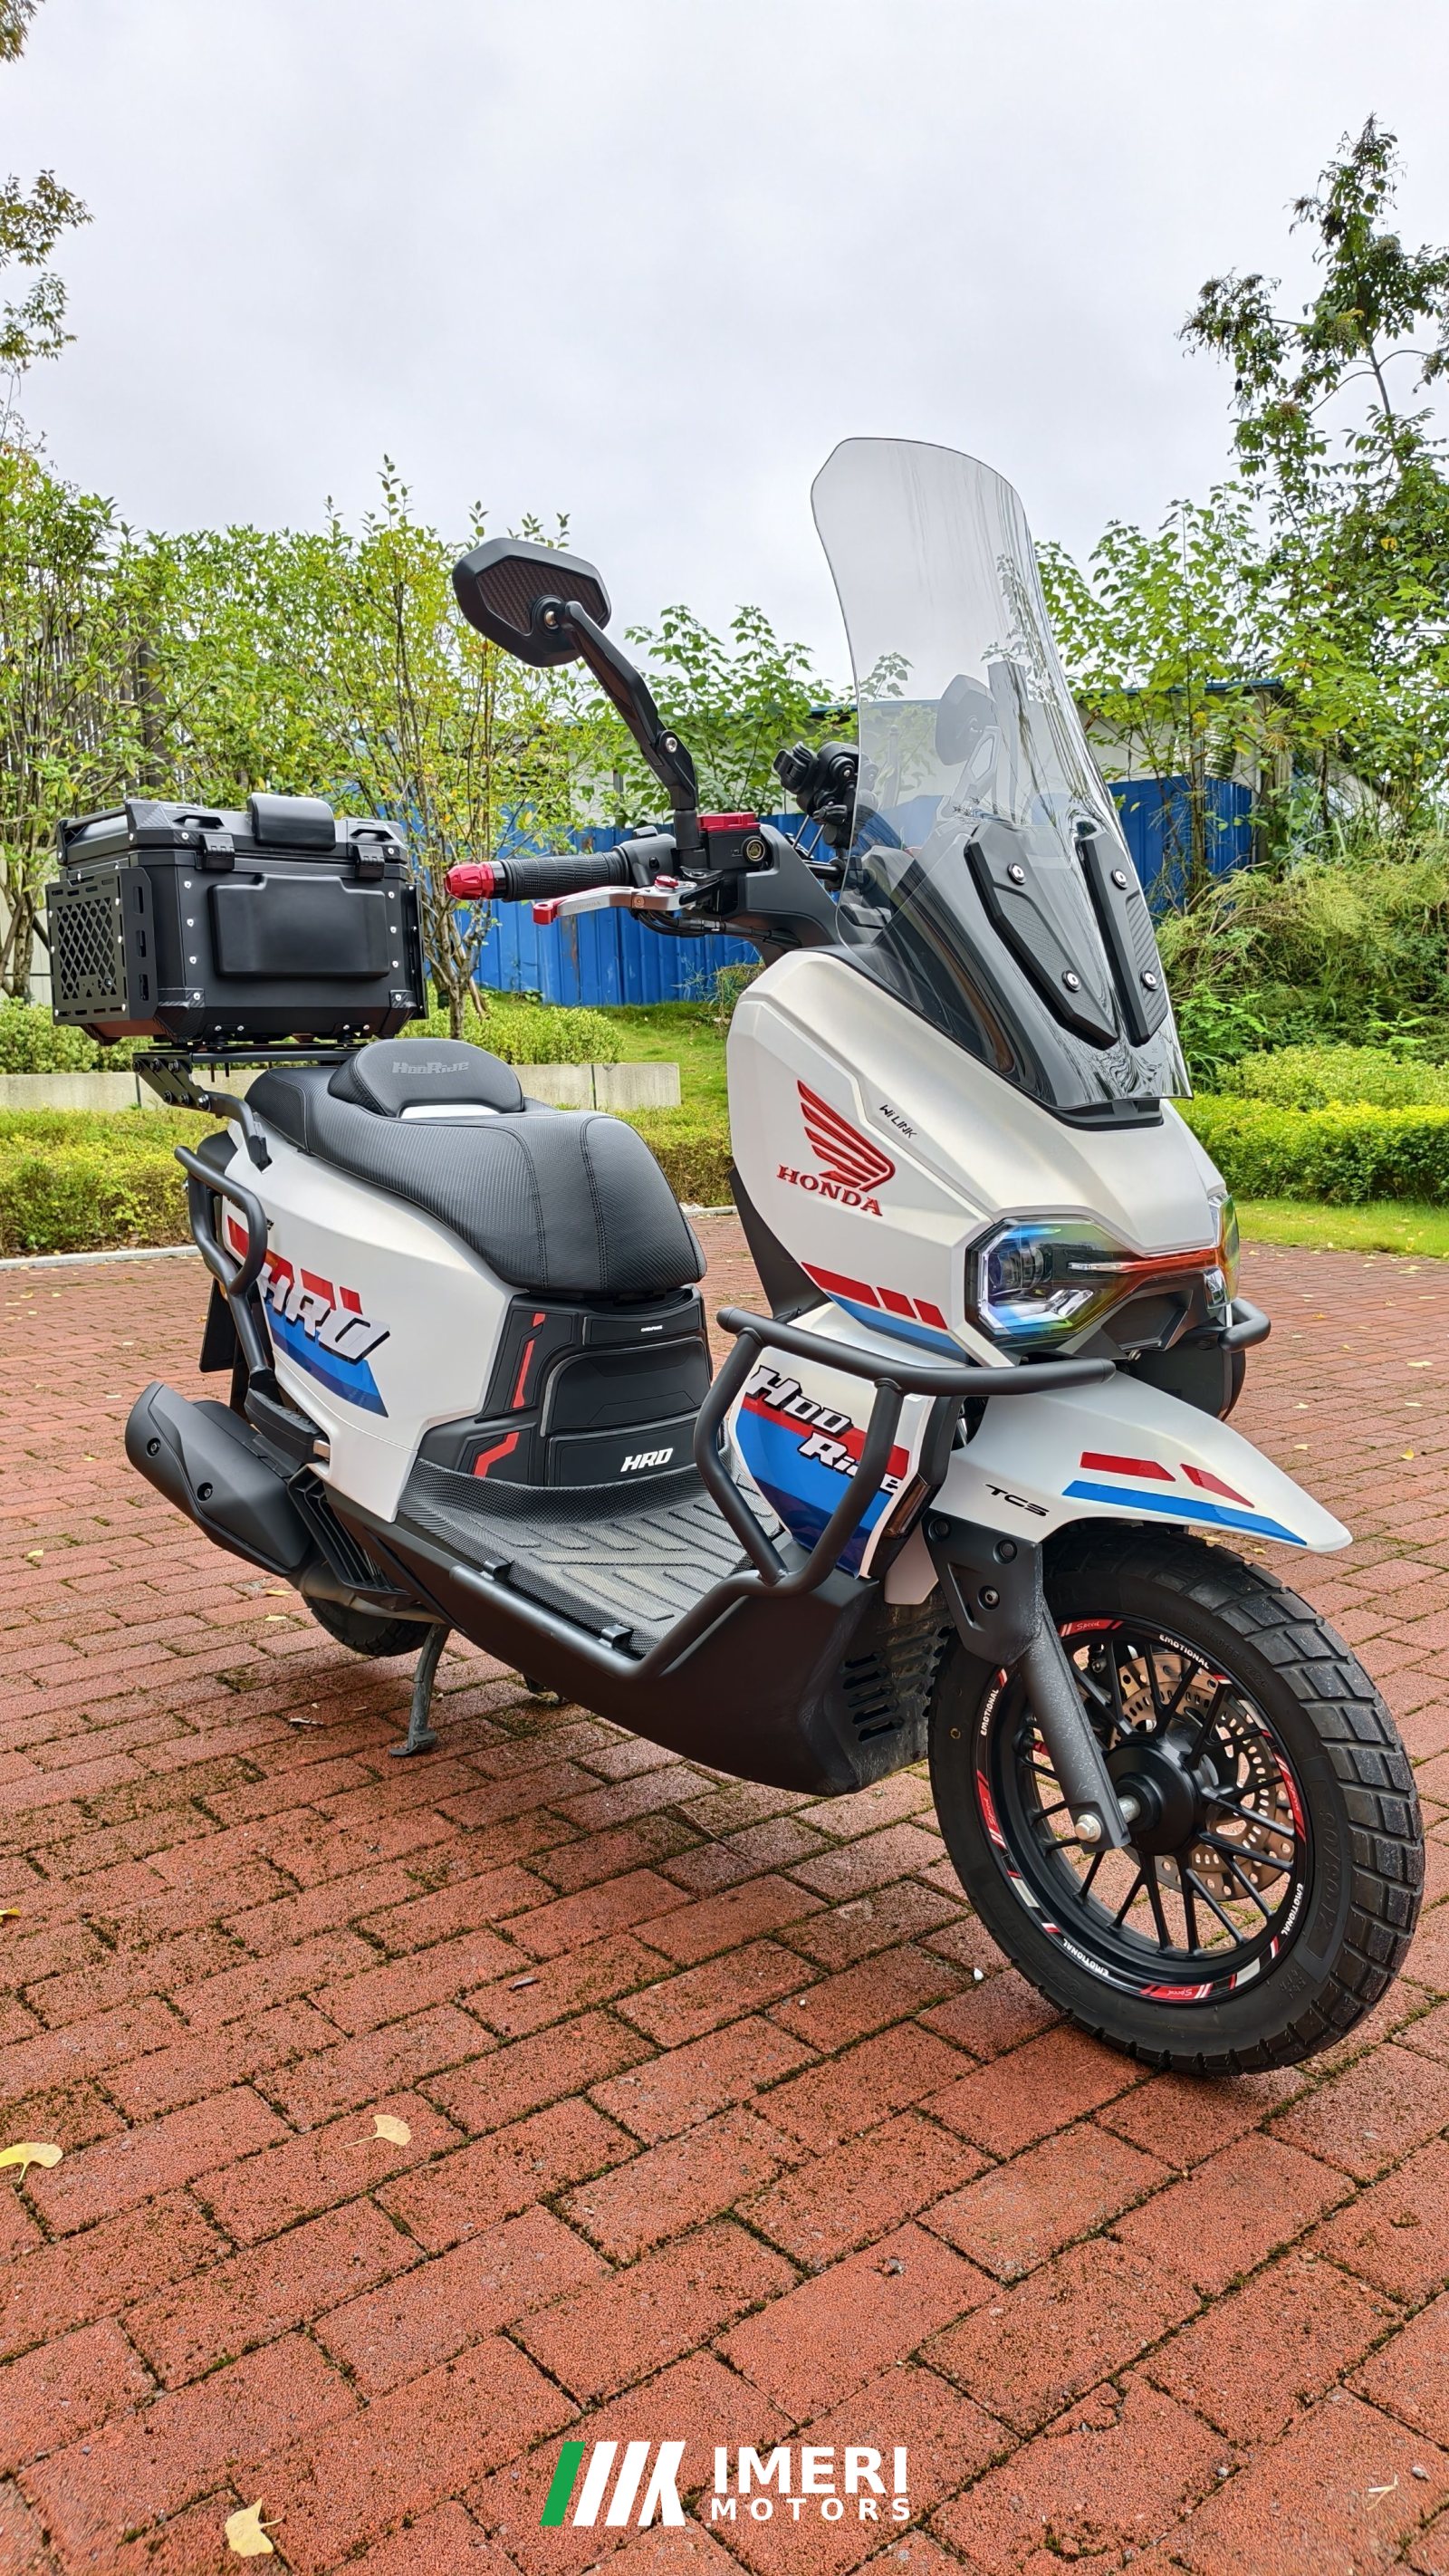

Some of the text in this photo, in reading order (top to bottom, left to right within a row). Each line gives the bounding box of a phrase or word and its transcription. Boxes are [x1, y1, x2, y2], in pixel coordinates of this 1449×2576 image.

[891, 1116, 916, 1139] LINK
[776, 1165, 883, 1216] HONDA
[620, 1447, 674, 1473] HRD
[985, 1484, 1050, 1516] TCS
[1159, 1634, 1210, 1669] EMOTIONAL
[981, 1689, 999, 1735] EMOTIONAL
[1281, 1883, 1304, 1936] EMOTIONAL
[1063, 1937, 1109, 1976] EMOTIONAL
